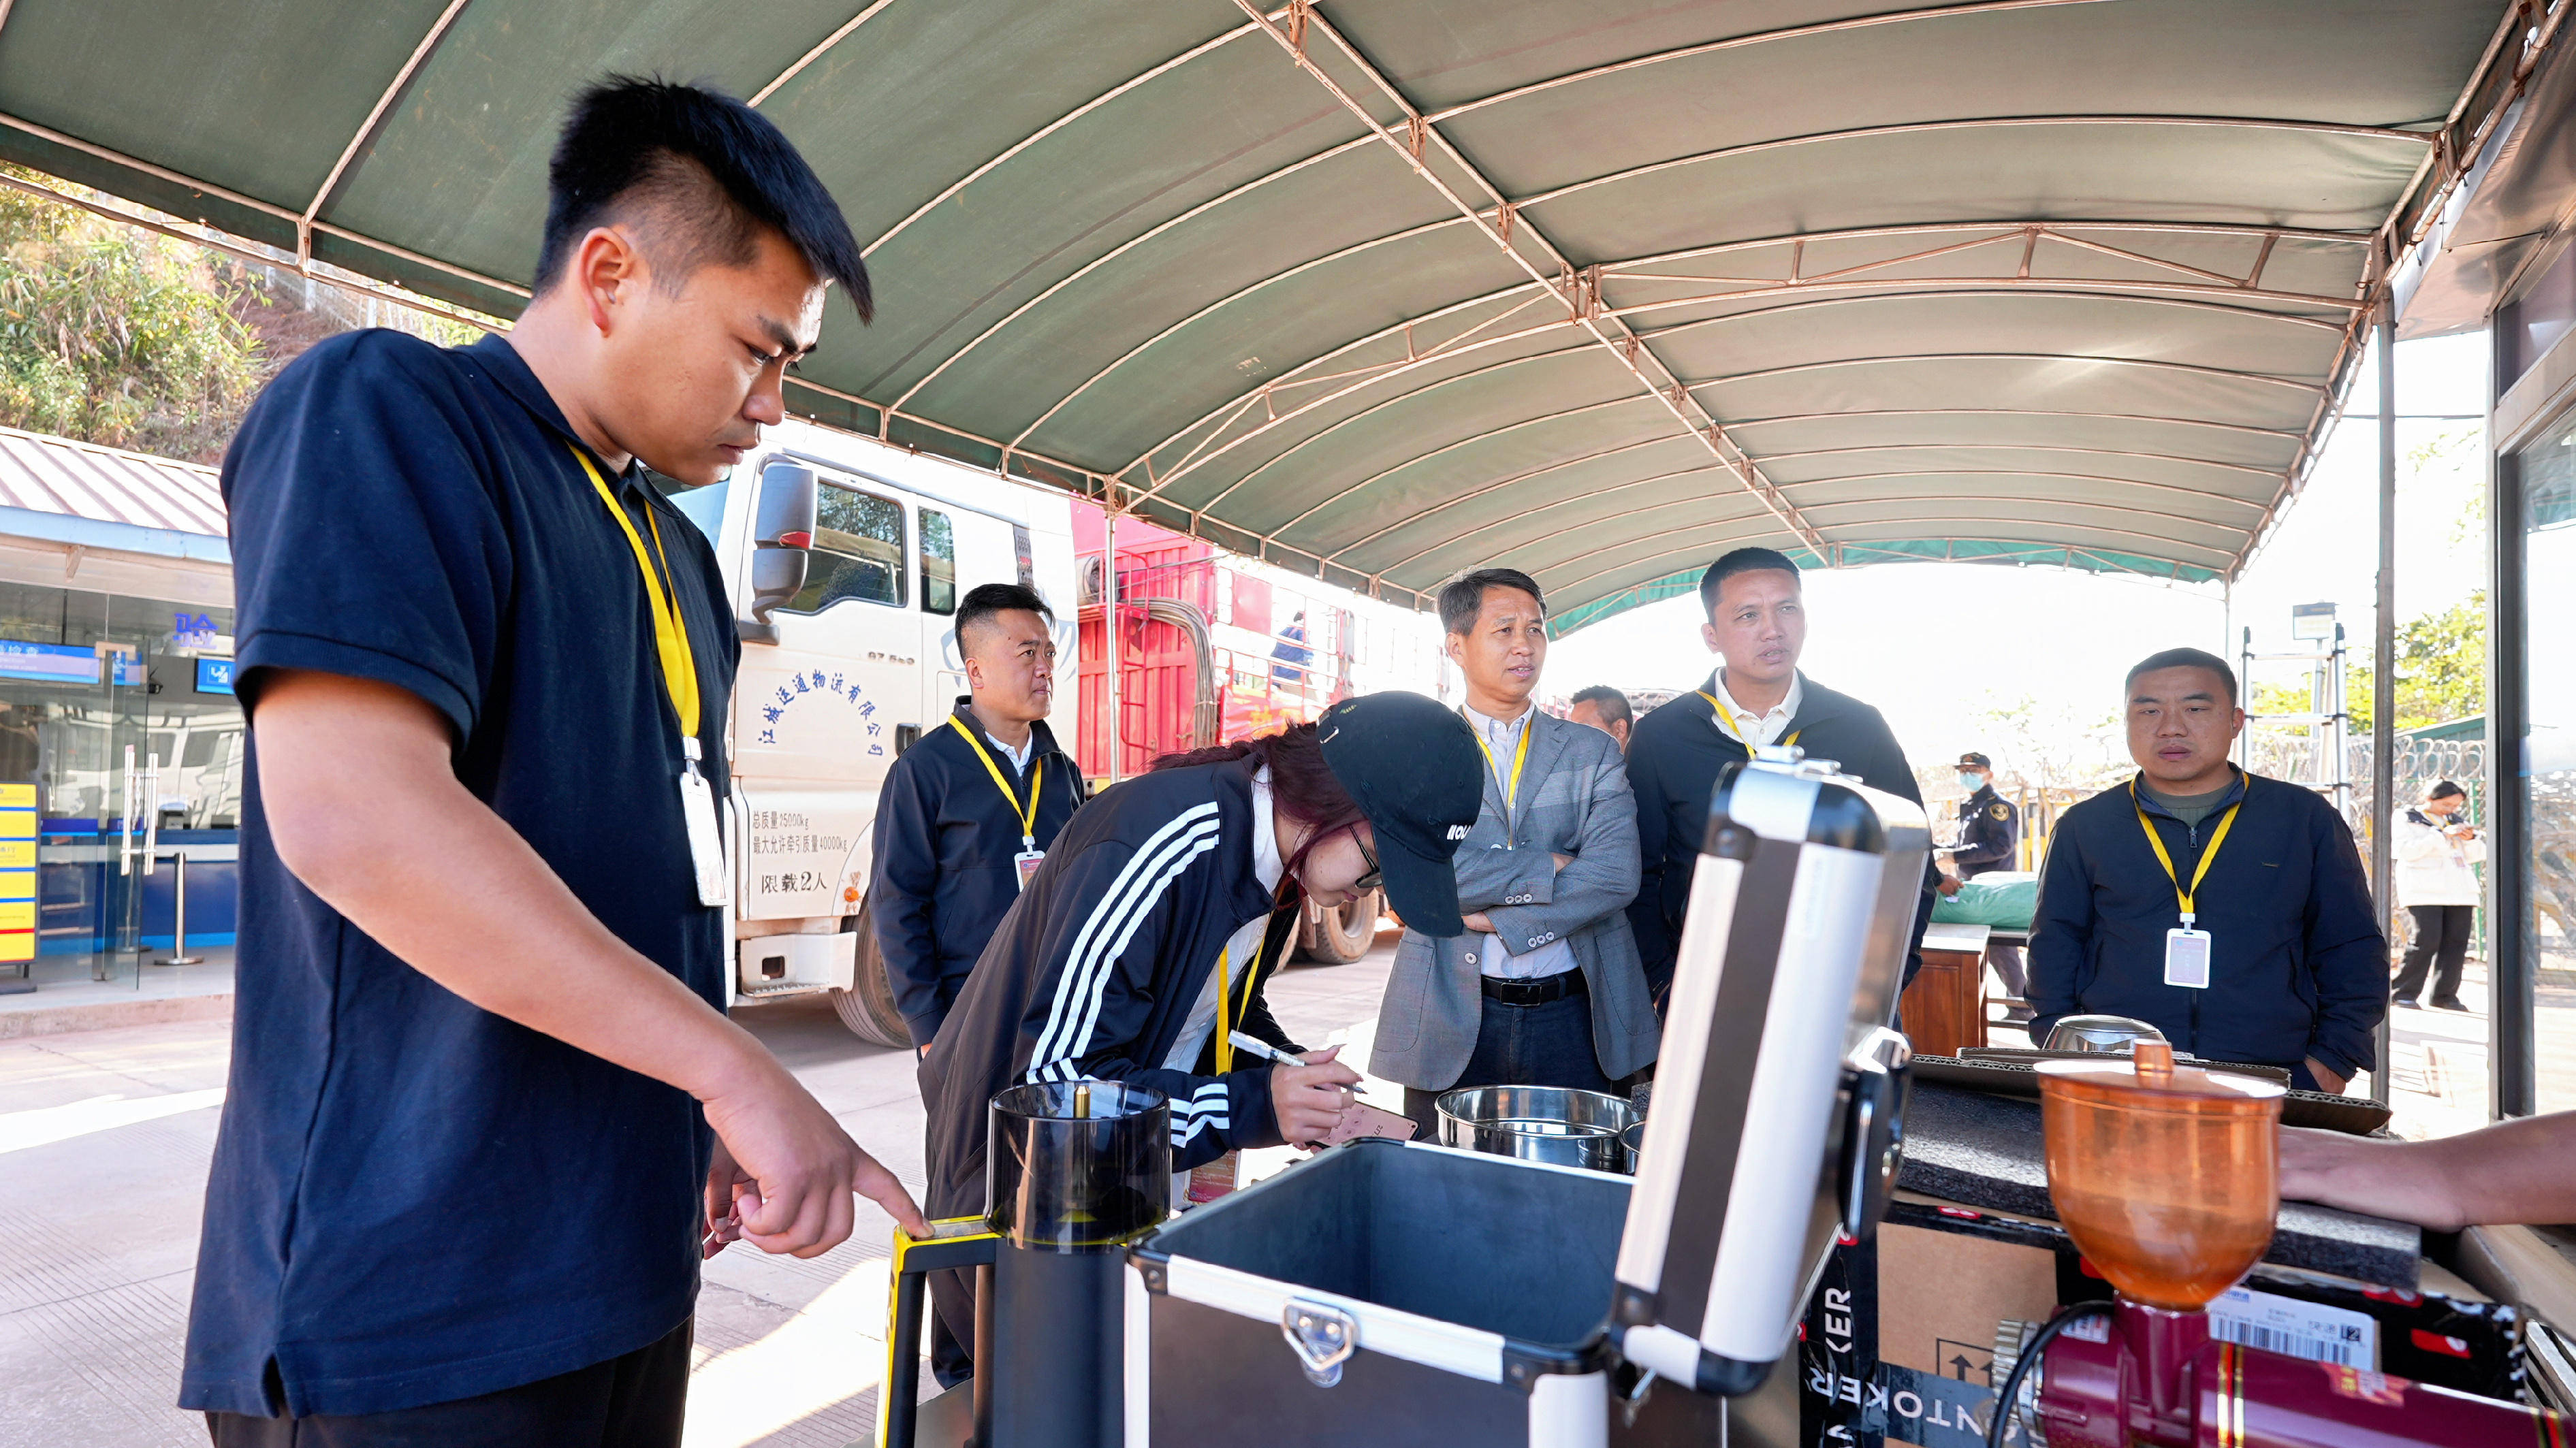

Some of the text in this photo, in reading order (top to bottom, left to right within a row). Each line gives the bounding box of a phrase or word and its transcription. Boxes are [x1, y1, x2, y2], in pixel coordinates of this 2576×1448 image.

[761, 871, 827, 894] 限载2人
[1810, 1367, 1984, 1436] NTOKER
